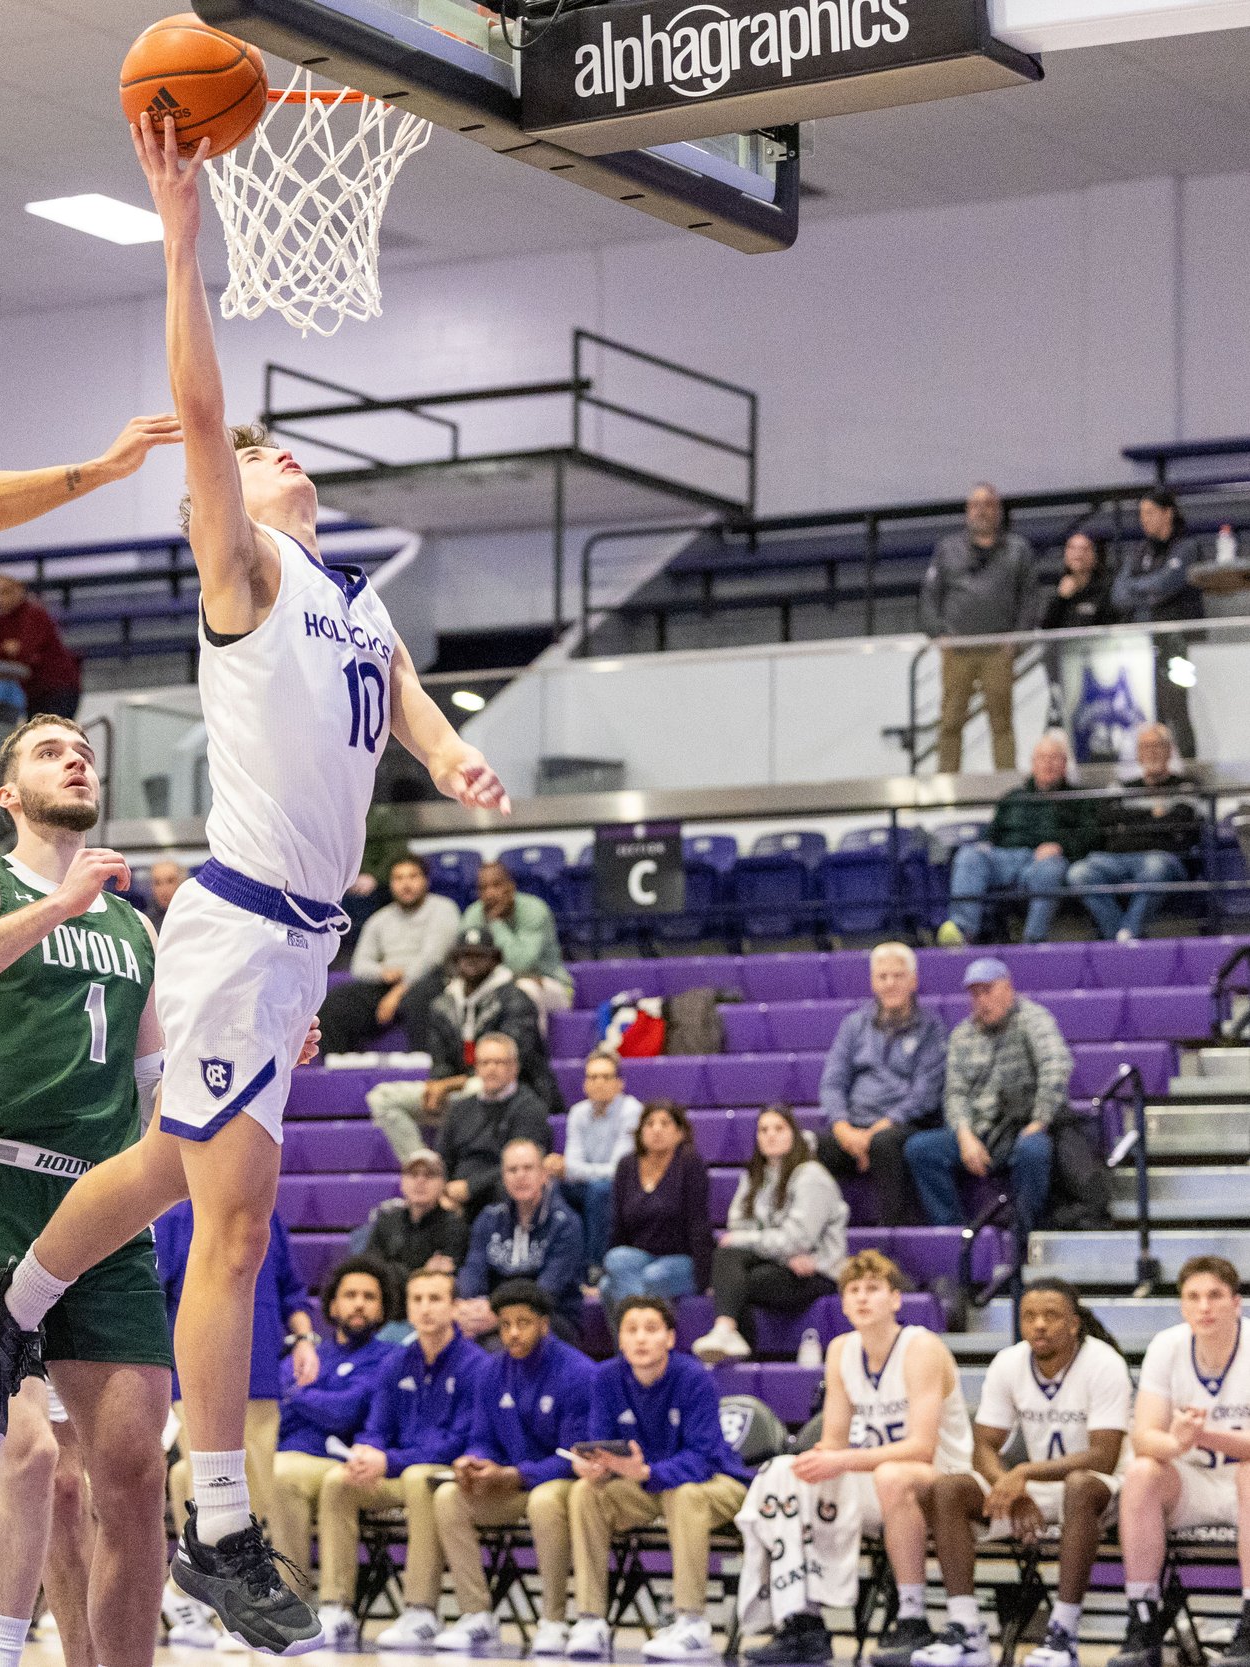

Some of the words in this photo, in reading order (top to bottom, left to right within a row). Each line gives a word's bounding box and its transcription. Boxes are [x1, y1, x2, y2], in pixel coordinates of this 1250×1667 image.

[574, 0, 910, 107] alphagraphics
[342, 656, 385, 754] 10
[627, 859, 659, 906] C
[41, 923, 141, 984] LOYOLA
[83, 982, 108, 1065] 1
